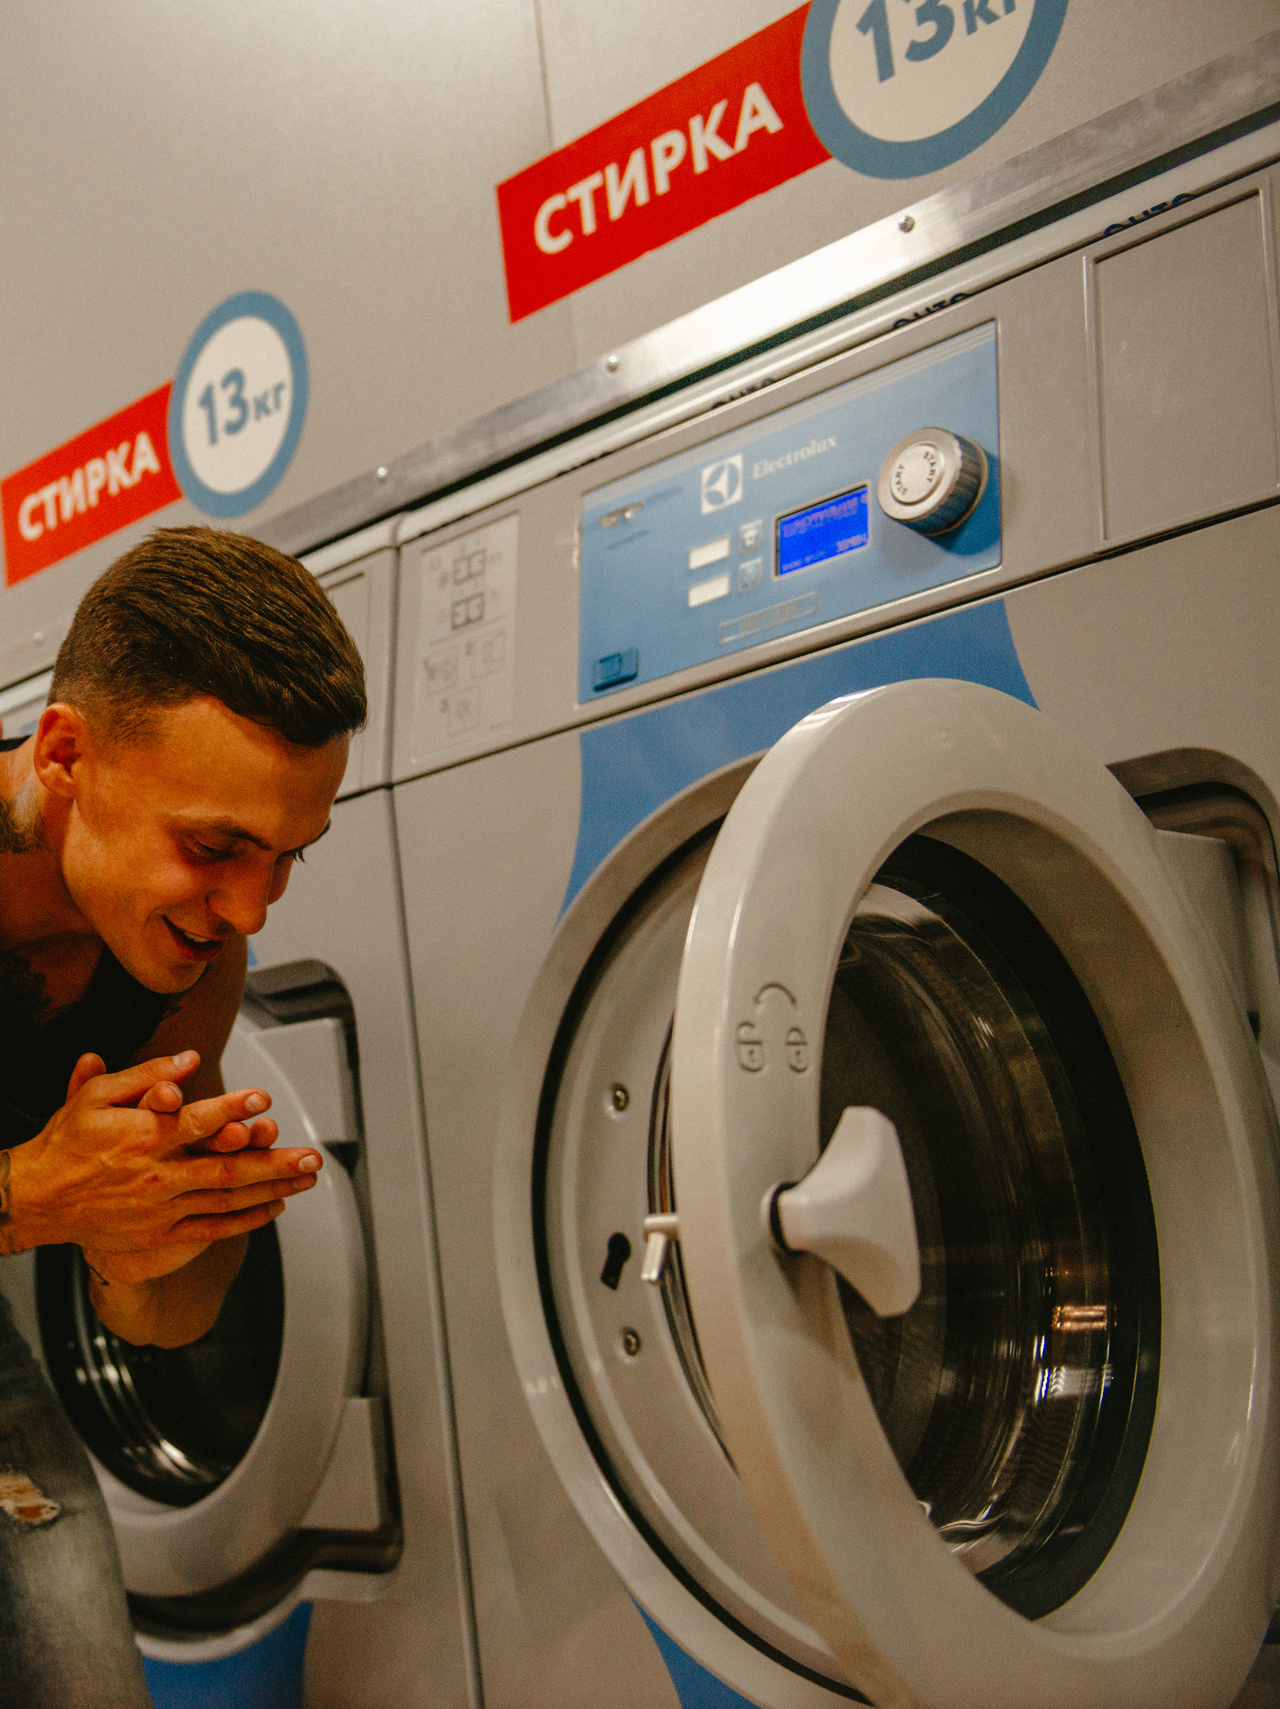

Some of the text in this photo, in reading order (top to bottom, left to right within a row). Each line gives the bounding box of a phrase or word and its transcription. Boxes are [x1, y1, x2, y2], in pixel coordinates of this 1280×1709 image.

[532, 81, 785, 255] СТИРКА
[18, 368, 285, 541] СТИРКА 13кг
[752, 436, 837, 479] Electrolux
[923, 451, 937, 483] START
